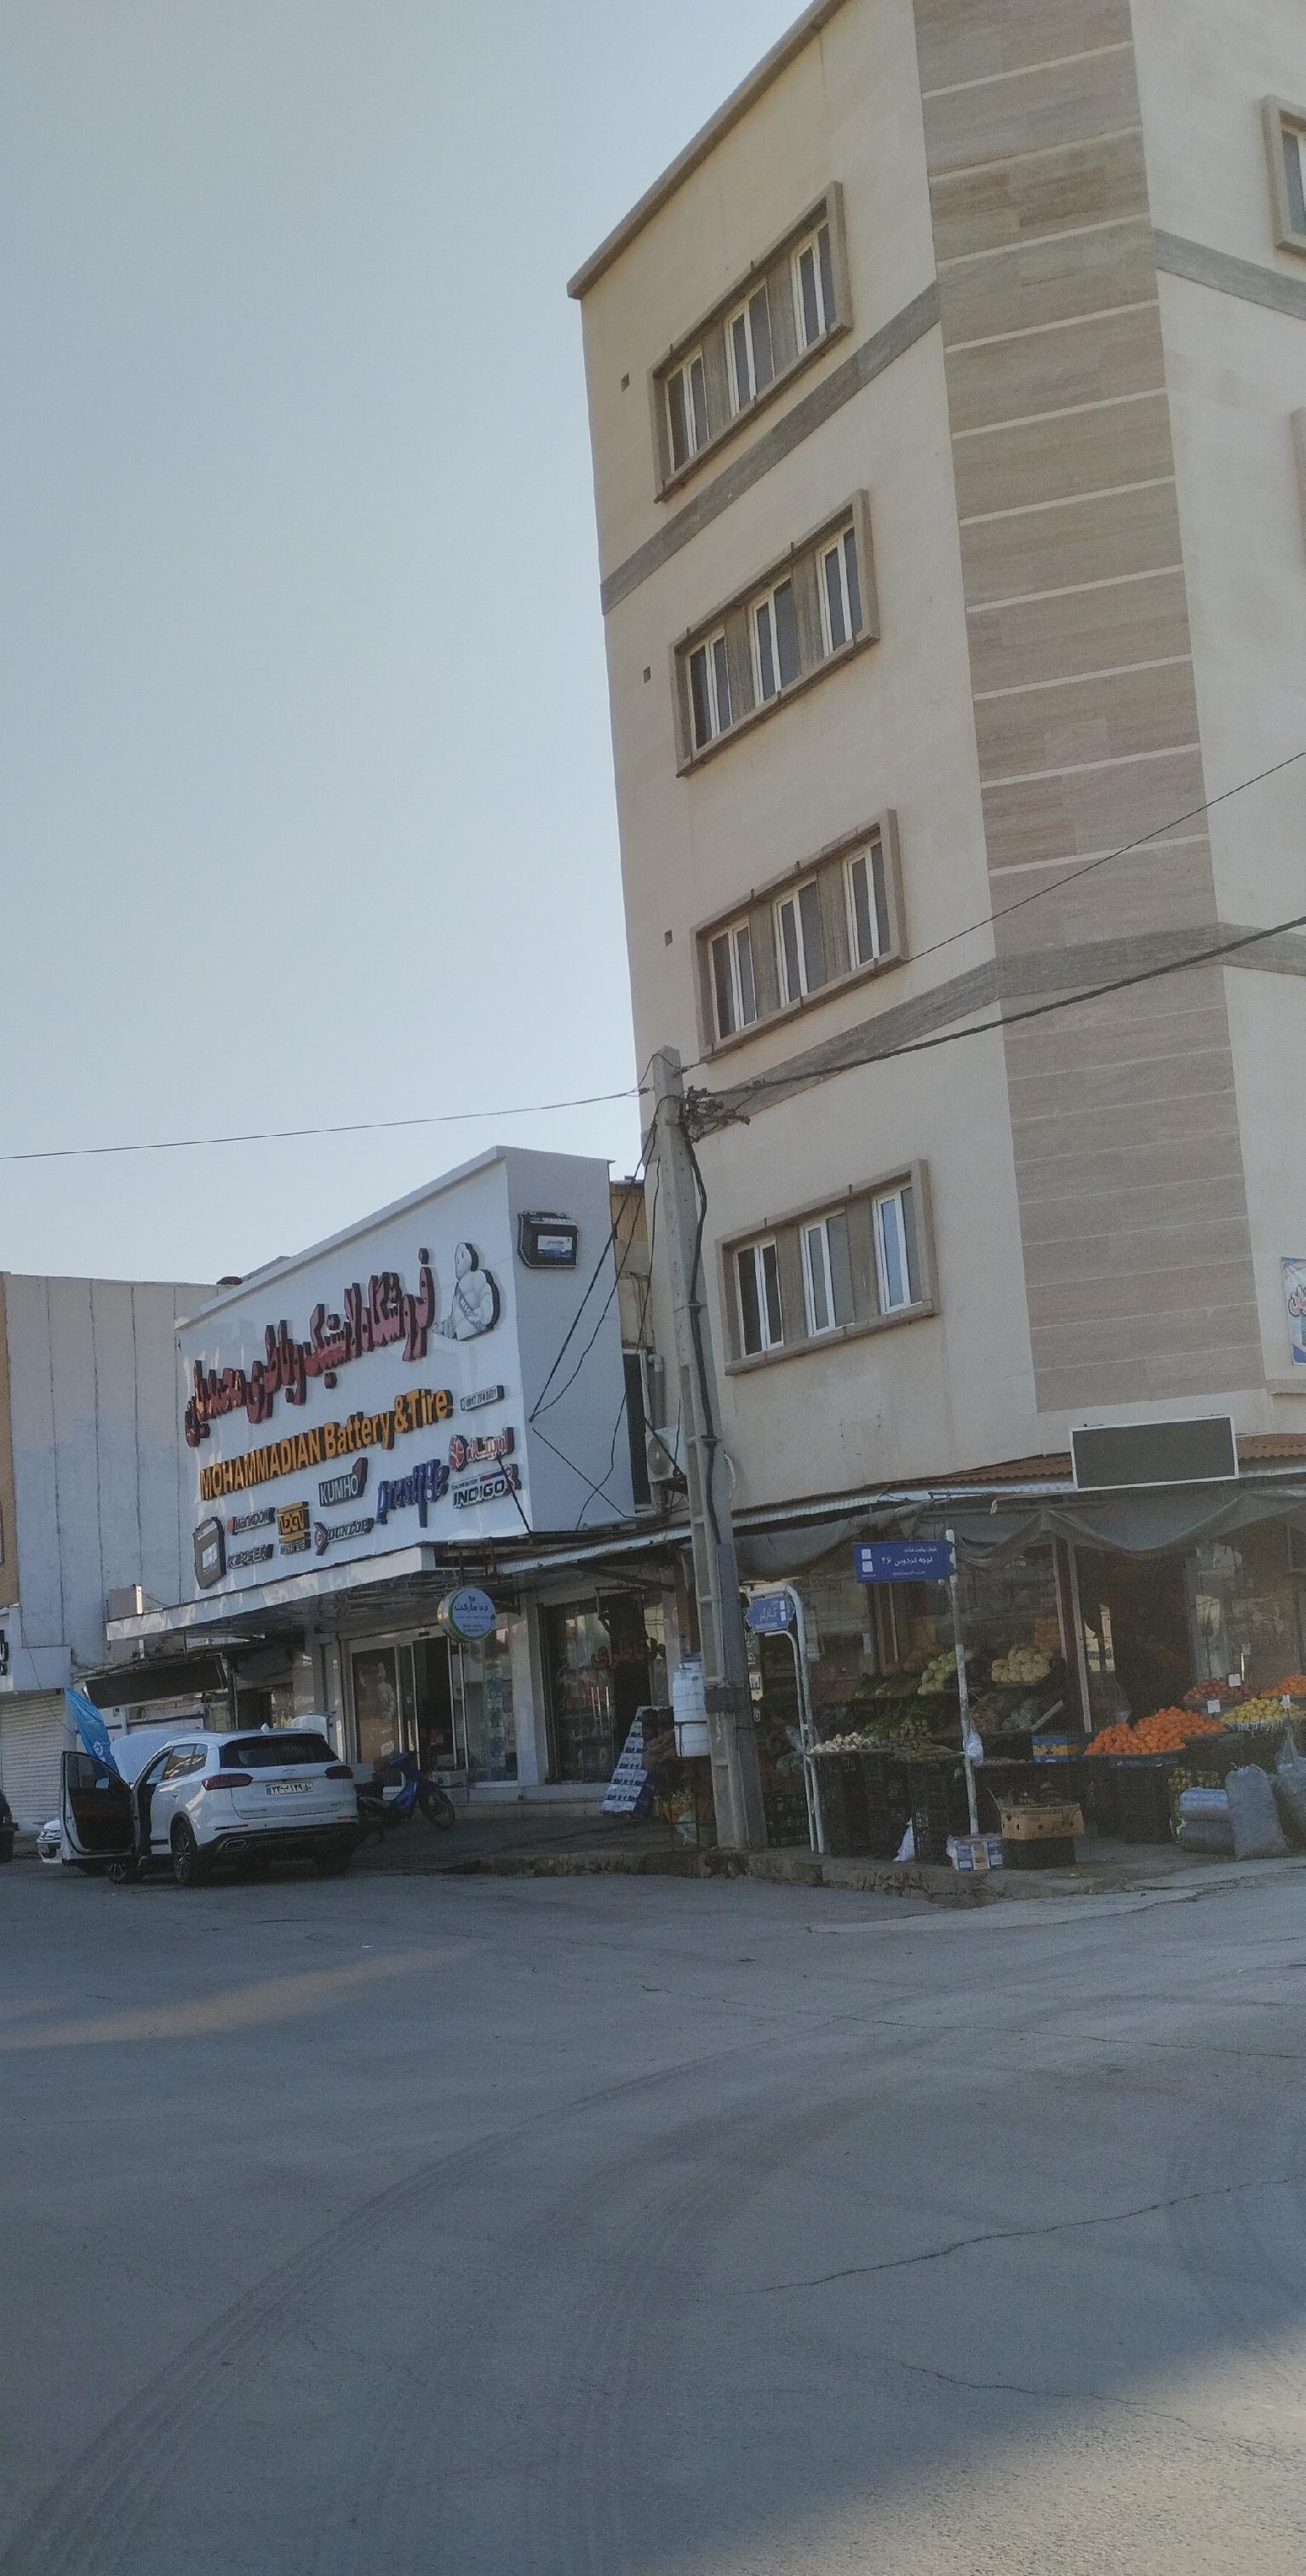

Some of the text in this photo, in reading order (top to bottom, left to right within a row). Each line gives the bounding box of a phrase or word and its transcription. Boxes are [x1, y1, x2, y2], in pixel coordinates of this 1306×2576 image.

[362, 1248, 435, 1361] فروشگاه
[200, 1426, 325, 1500] MOHAMMADIAN
[324, 1411, 394, 1449] Battery
[319, 1474, 359, 1505] KUMHO
[453, 1480, 506, 1506] INDIGO
[919, 1556, 933, 1564] کوچه
